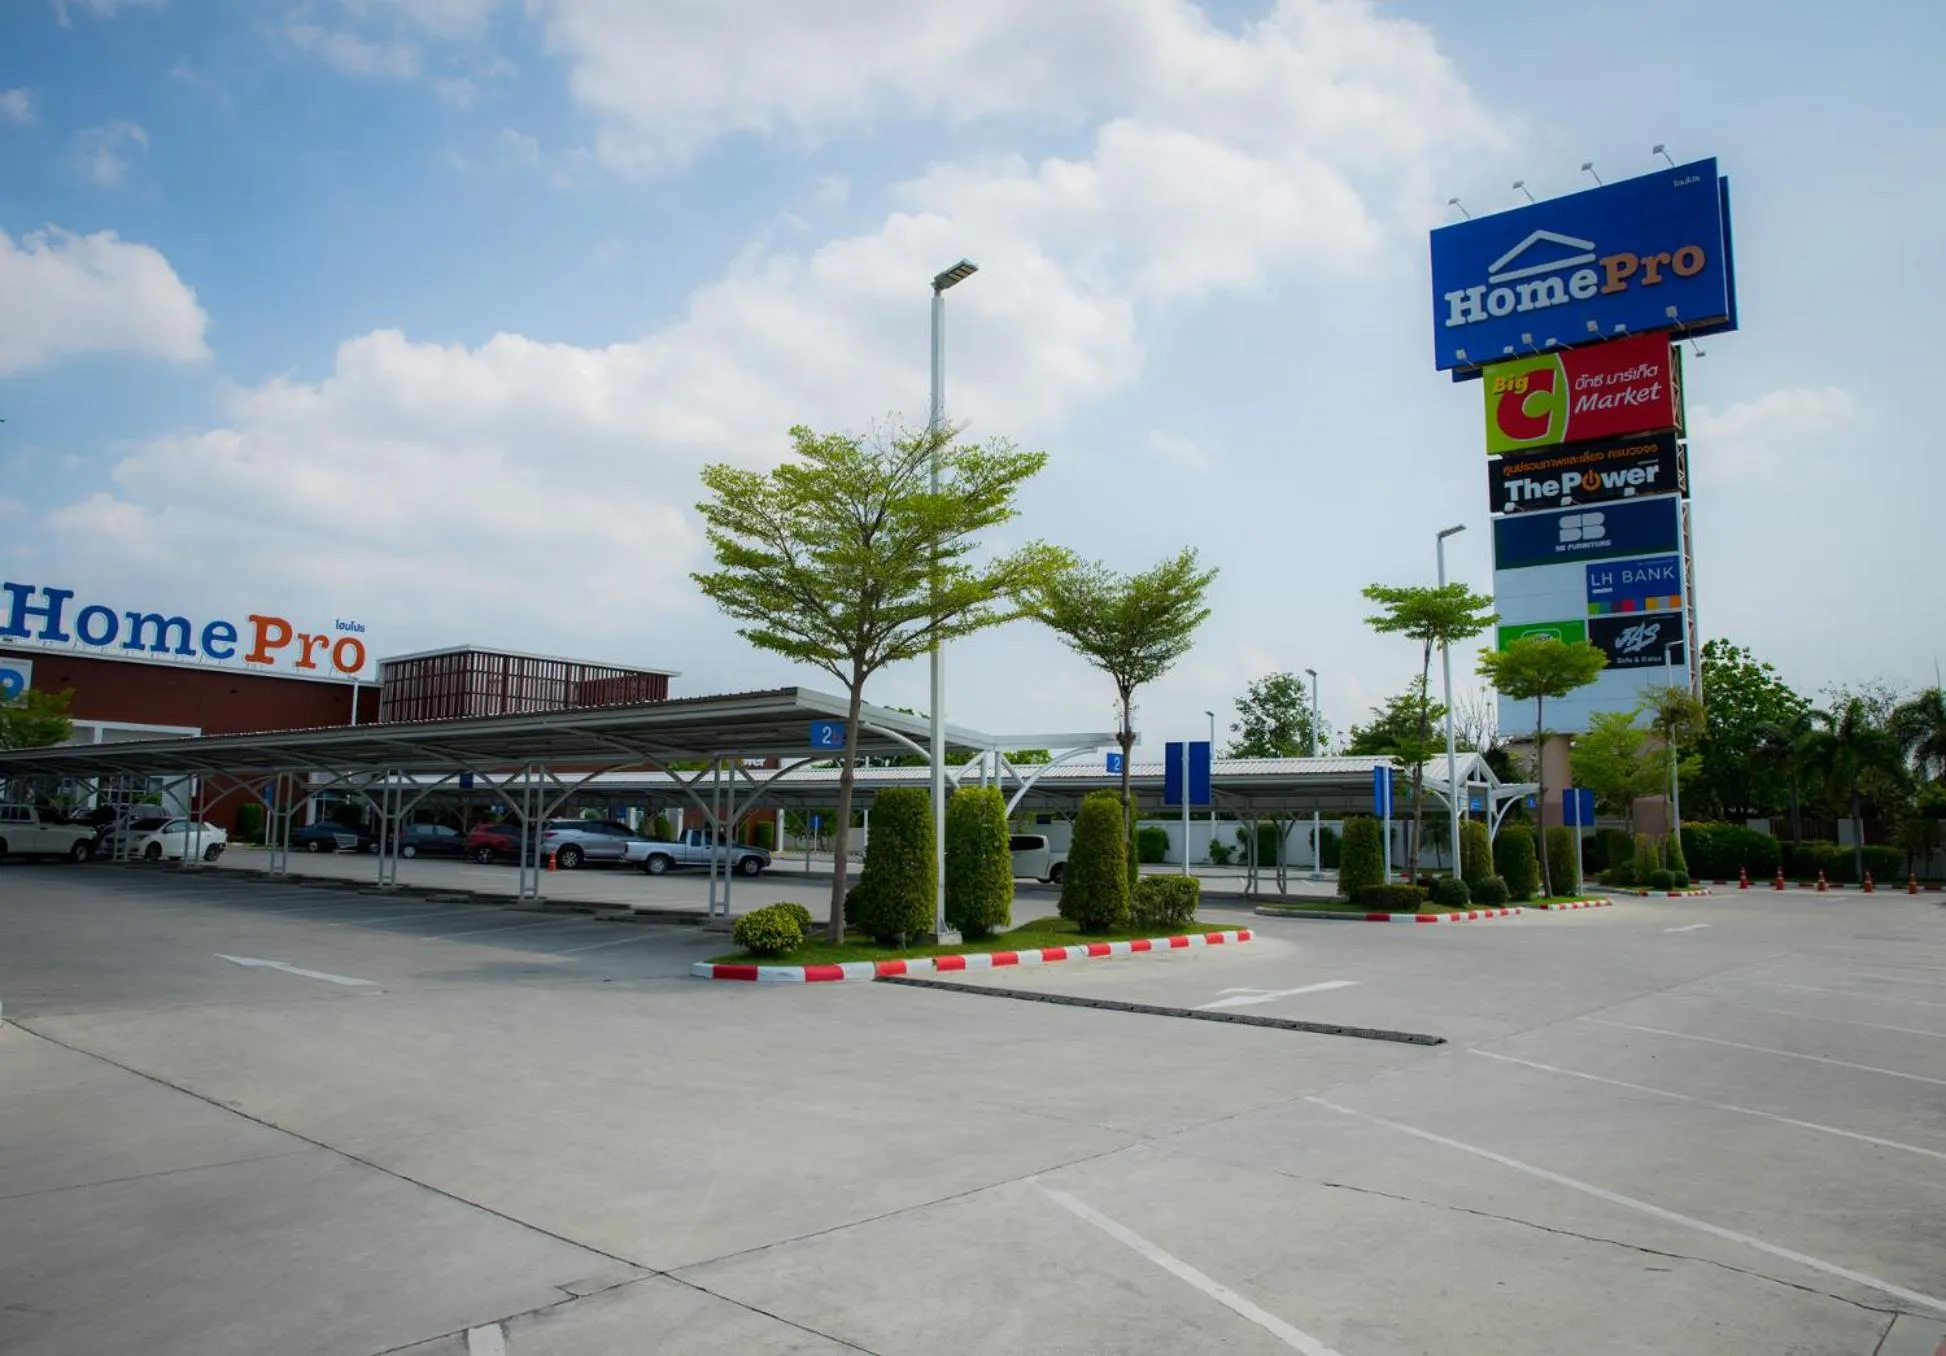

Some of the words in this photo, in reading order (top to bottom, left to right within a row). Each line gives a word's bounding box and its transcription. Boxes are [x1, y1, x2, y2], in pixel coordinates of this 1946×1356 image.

[1445, 245, 1705, 327] HomePro
[1493, 373, 1529, 395] Big
[1574, 381, 1662, 414] Market
[1591, 572, 1613, 587] LH
[1622, 566, 1675, 584] BANK
[0, 582, 366, 673] HomePro
